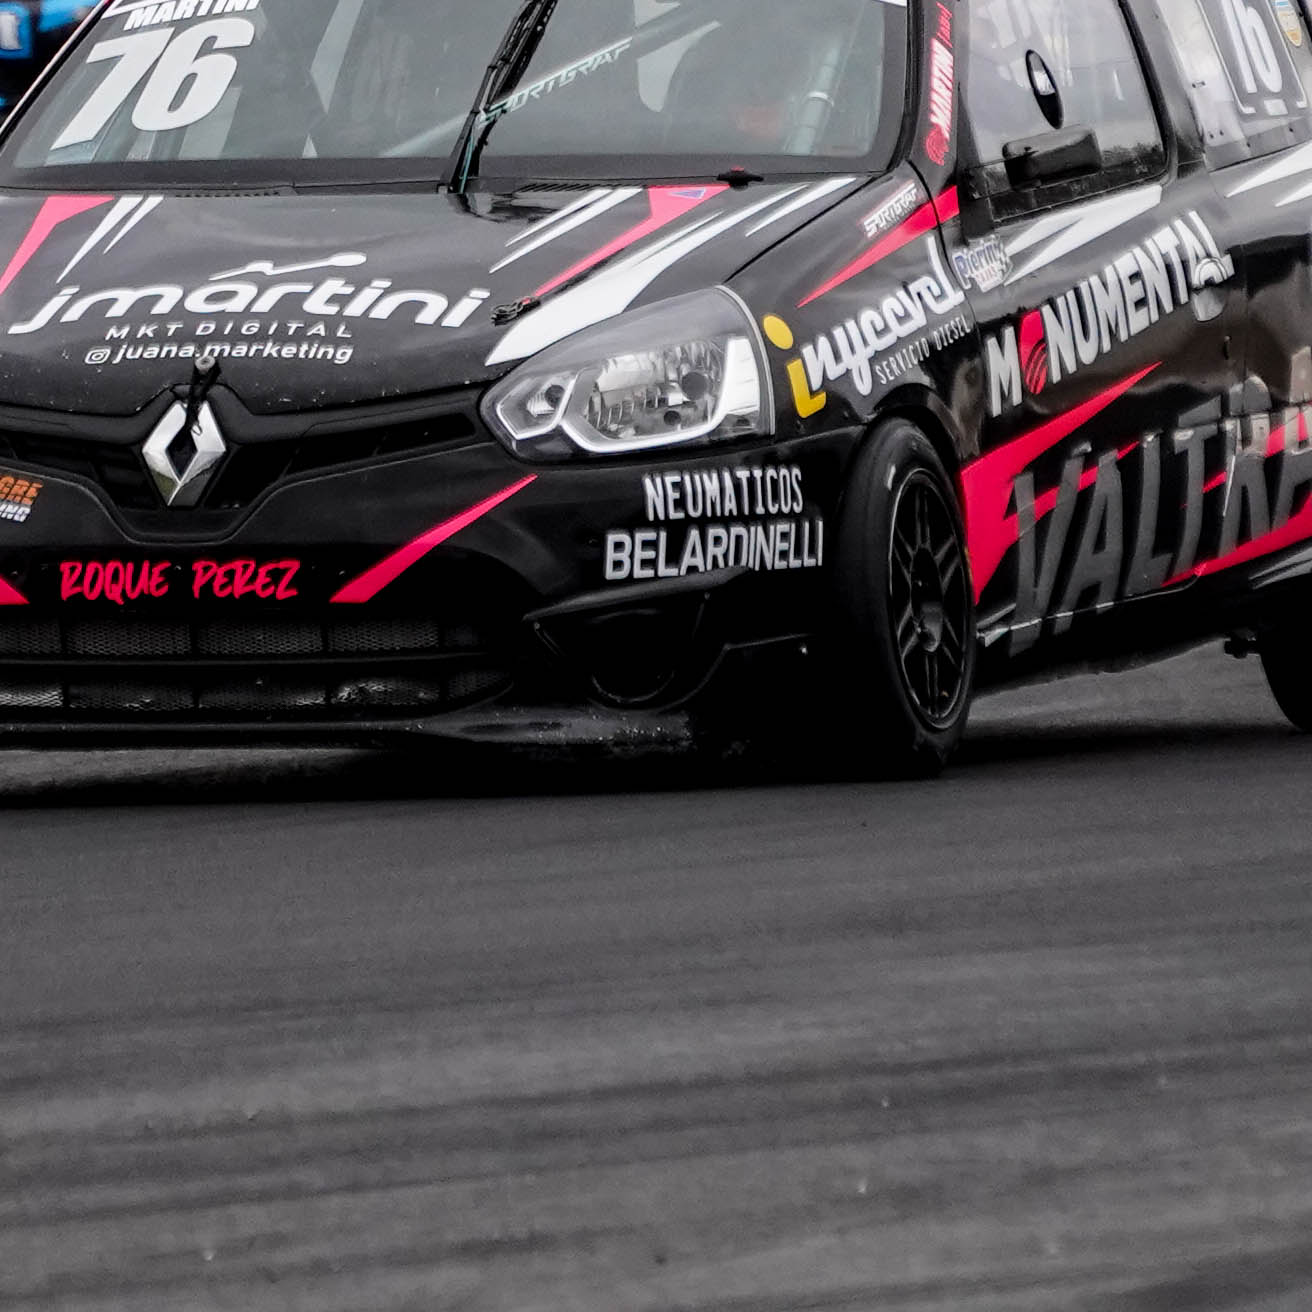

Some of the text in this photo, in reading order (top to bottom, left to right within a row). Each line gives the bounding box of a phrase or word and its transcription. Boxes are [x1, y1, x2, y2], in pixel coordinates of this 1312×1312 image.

[49, 16, 256, 151] 76
[7, 278, 491, 336] jmartini
[104, 319, 355, 341] MKT DIGITAL
[874, 314, 973, 386] SERVICIO DIESEL
[641, 464, 804, 523] NEUMATICOS
[603, 519, 825, 582] BELARDINELLI
[59, 559, 301, 604] ROQUE PEREZ
